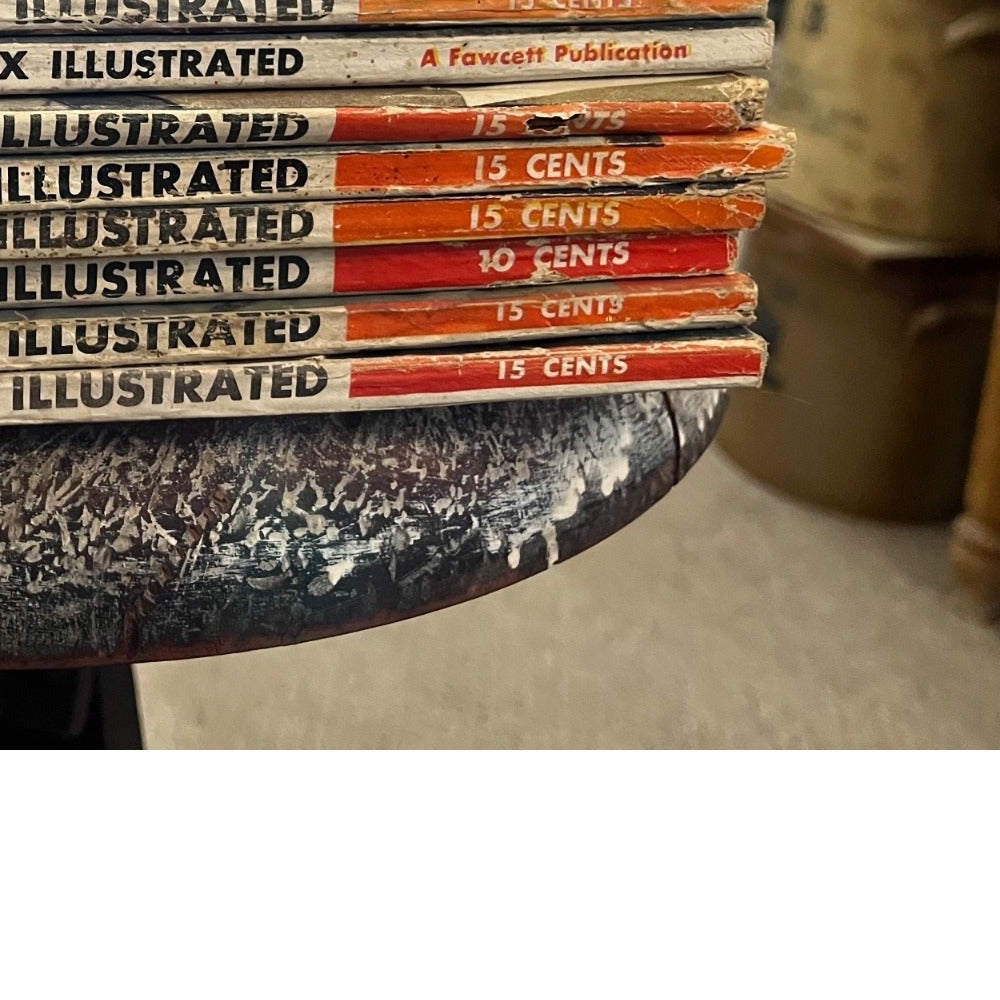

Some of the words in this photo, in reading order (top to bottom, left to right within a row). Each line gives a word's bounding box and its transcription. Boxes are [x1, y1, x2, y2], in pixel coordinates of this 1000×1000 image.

[51, 47, 304, 80] ILLUSTRATED
[420, 48, 438, 68] A
[449, 47, 544, 67] Fawcett
[555, 40, 689, 64] Publication
[472, 114, 507, 136] 15
[530, 109, 626, 130] NTS
[475, 154, 507, 181] 15
[526, 151, 626, 180] CENTS
[469, 203, 501, 231] 15
[522, 201, 620, 228] CENTS
[479, 247, 515, 273] 10
[533, 241, 630, 269] CENTS
[496, 301, 523, 321] 15
[541, 296, 623, 318] CENTS
[8, 310, 320, 357] ILLUSTRATED
[498, 358, 525, 380] 15
[543, 355, 628, 378] CENTS
[13, 363, 328, 410] ILLUSTRATED
